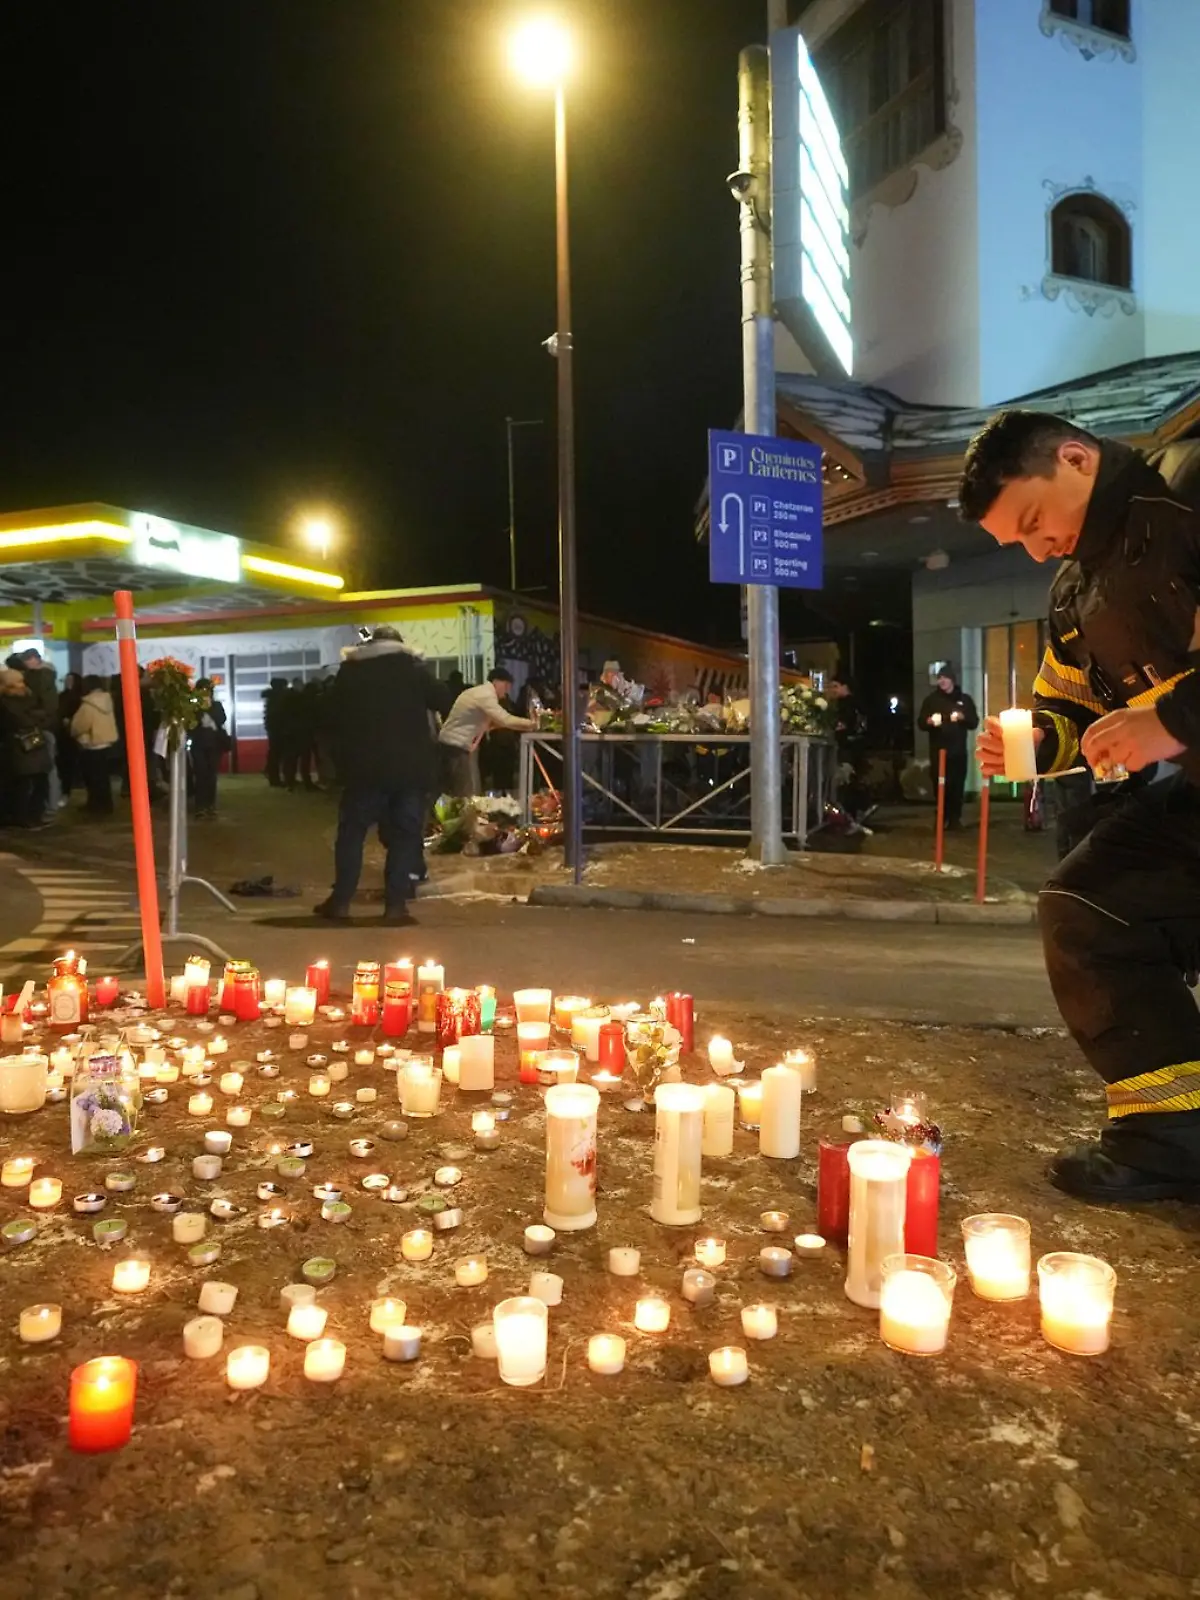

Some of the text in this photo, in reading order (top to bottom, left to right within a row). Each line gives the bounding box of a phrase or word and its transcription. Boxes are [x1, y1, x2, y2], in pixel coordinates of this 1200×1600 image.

[723, 448, 737, 468] P
[748, 460, 817, 484] Lanternes
[754, 501, 767, 514] P1
[753, 530, 768, 542] P3
[754, 558, 768, 571] P5
